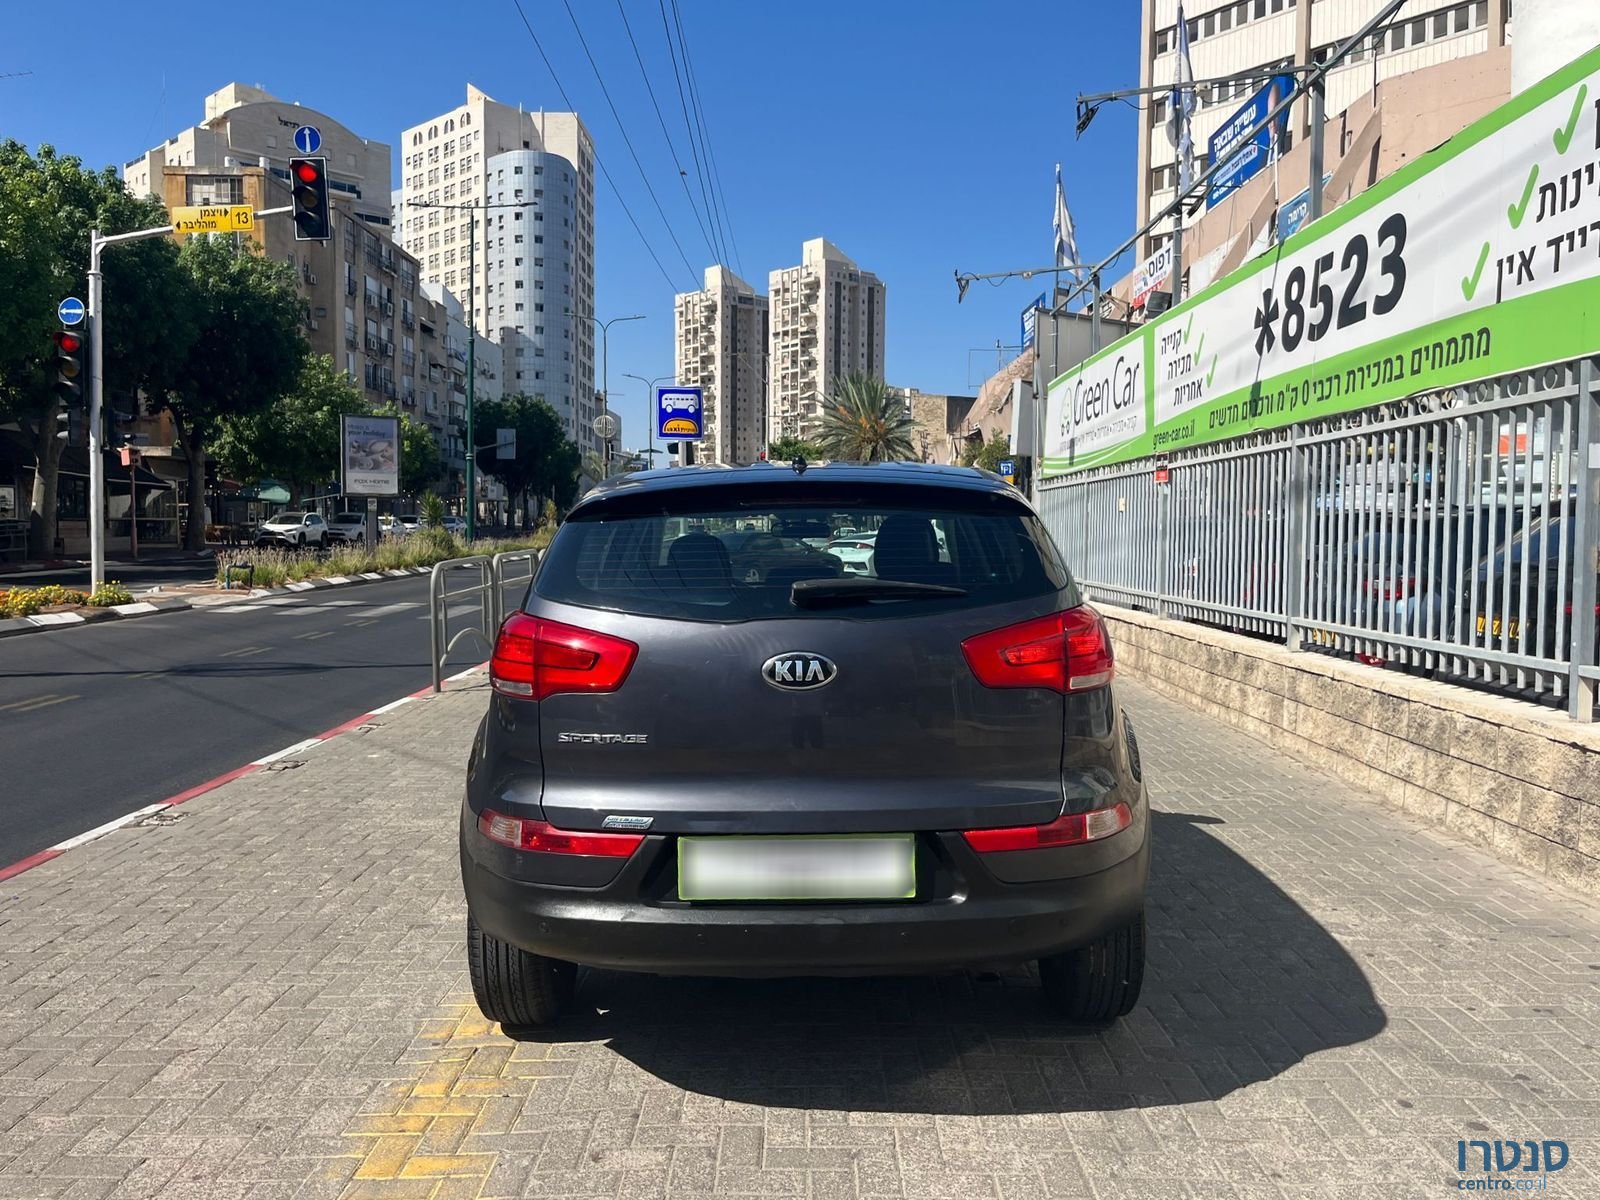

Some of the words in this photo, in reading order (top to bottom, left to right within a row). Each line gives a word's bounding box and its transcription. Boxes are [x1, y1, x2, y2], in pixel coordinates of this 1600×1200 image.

[1536, 160, 1600, 223] ינות
[183, 218, 217, 229] מוהליבר
[200, 208, 222, 219] ויצמן
[236, 212, 249, 224] 13
[1148, 247, 1171, 277] דפוס
[1495, 245, 1537, 304] אין
[1161, 328, 1182, 355] קנייה
[1410, 326, 1491, 377] מתמחים
[1168, 353, 1192, 381] מכירה
[1344, 353, 1405, 395] במכירת
[1073, 378, 1110, 426] Green
[1113, 355, 1139, 410] Car
[1173, 377, 1203, 407] אחריות
[1302, 379, 1310, 406] 0
[1312, 374, 1341, 402] רכבי
[1209, 404, 1239, 429] חדשים
[1153, 418, 1195, 450] green-car.co.il
[774, 660, 826, 682] KIA
[558, 732, 649, 744] SPORTAGE
